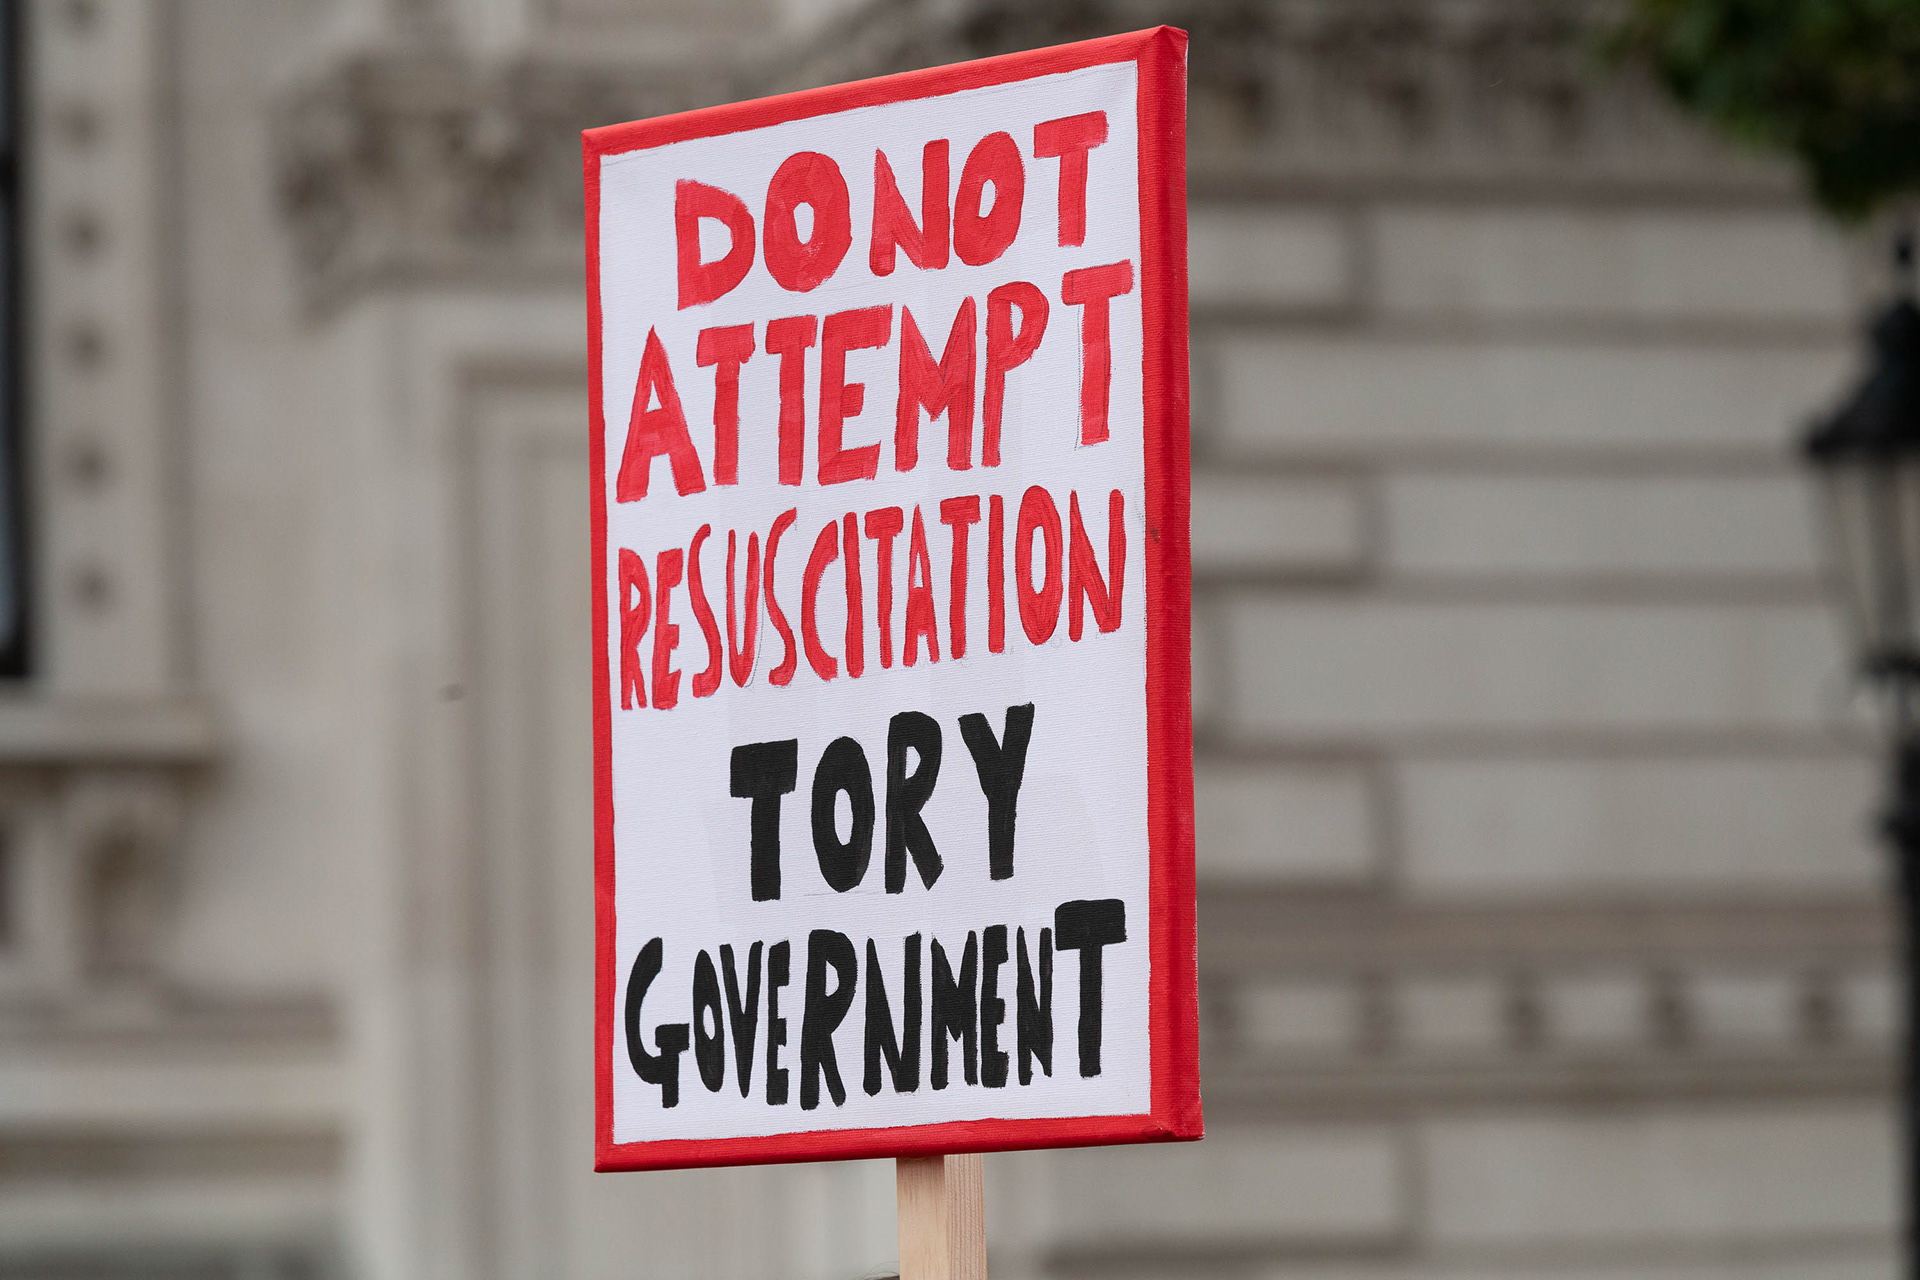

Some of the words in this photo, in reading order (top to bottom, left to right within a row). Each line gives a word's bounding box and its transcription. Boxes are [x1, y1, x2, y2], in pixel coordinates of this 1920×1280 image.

[676, 151, 852, 311] DO
[869, 110, 1109, 277] NOT
[616, 259, 1135, 503] ATTEMPT
[619, 485, 1126, 710] RESUSCITATION
[730, 701, 1035, 902] TORY
[625, 899, 1127, 1110] GOVERNMENT
